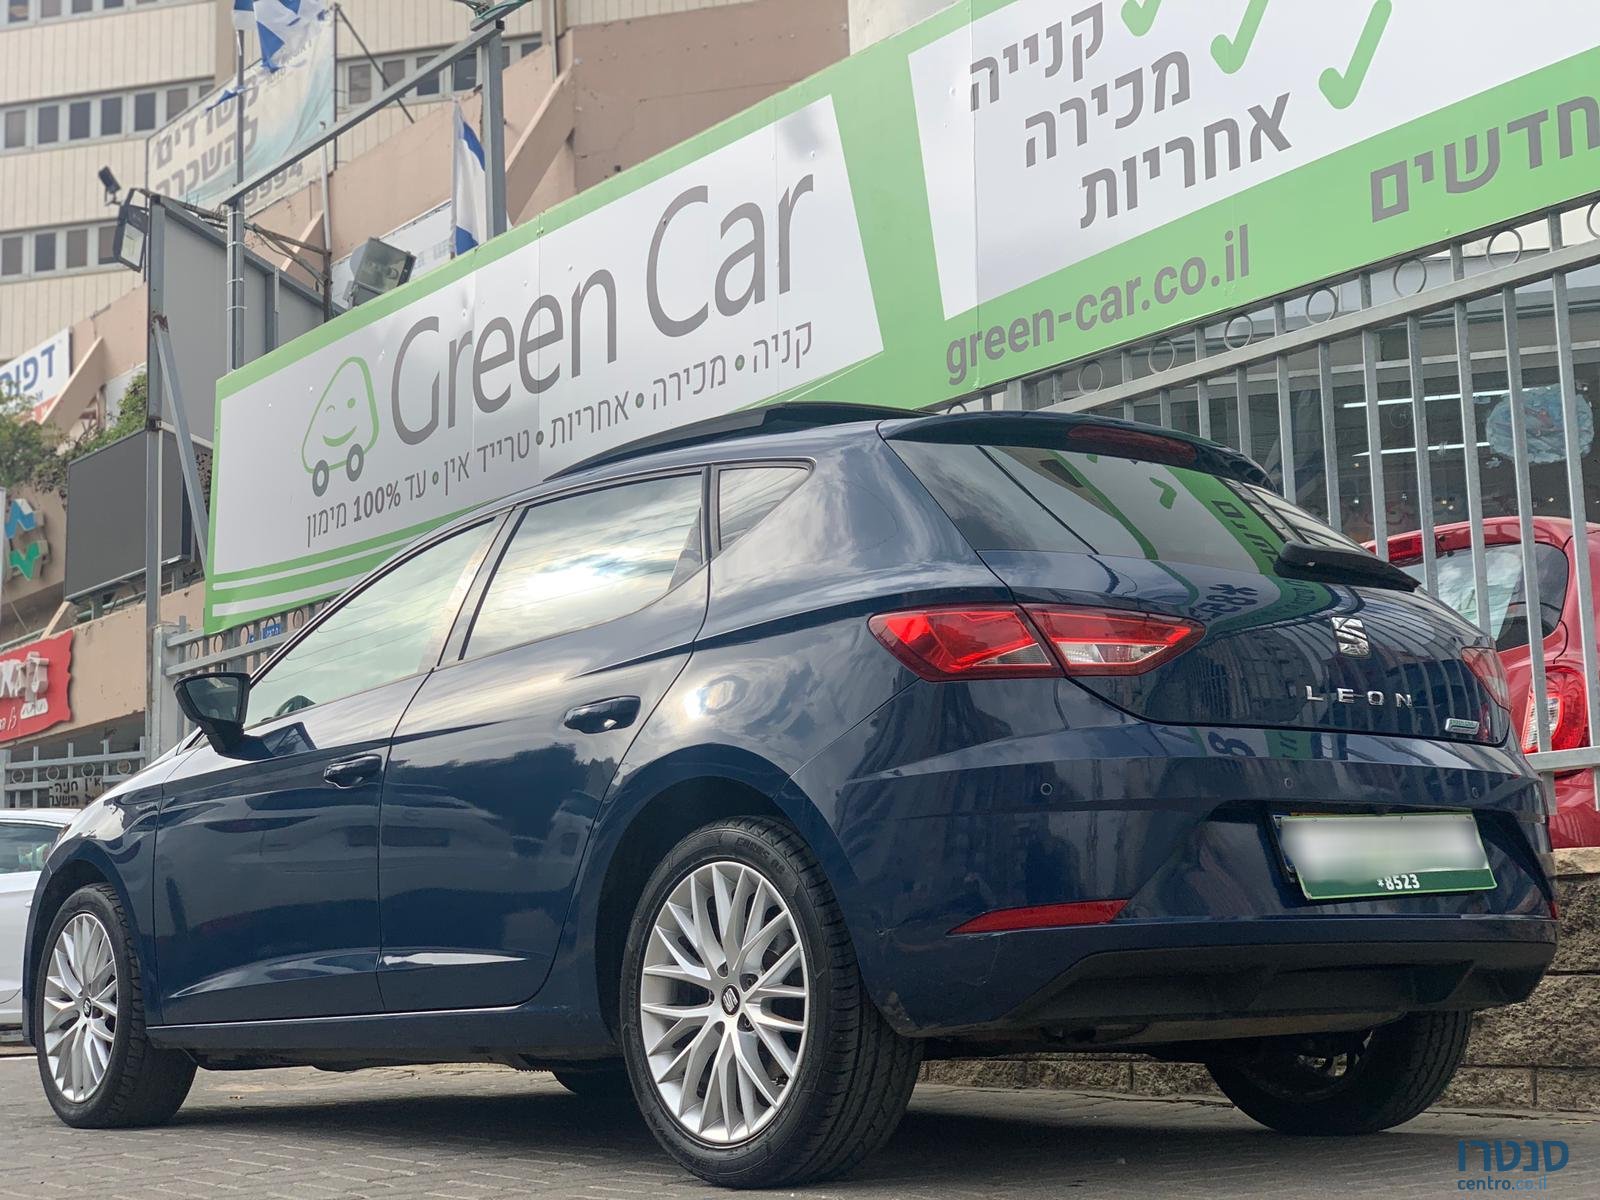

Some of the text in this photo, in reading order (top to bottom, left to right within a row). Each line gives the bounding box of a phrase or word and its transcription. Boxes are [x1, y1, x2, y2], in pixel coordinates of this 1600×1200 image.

[970, 2, 1104, 112] קנייה
[1025, 51, 1190, 168] מכירה
[1080, 92, 1292, 229] אחריות
[1370, 96, 1600, 223] חדשים
[391, 174, 814, 446] Green Car
[946, 224, 1249, 386] green-car.co.il
[307, 321, 812, 548] קניה מכירה אחריות טרייד אין עד 100% מימון
[1305, 685, 1413, 708] LEON
